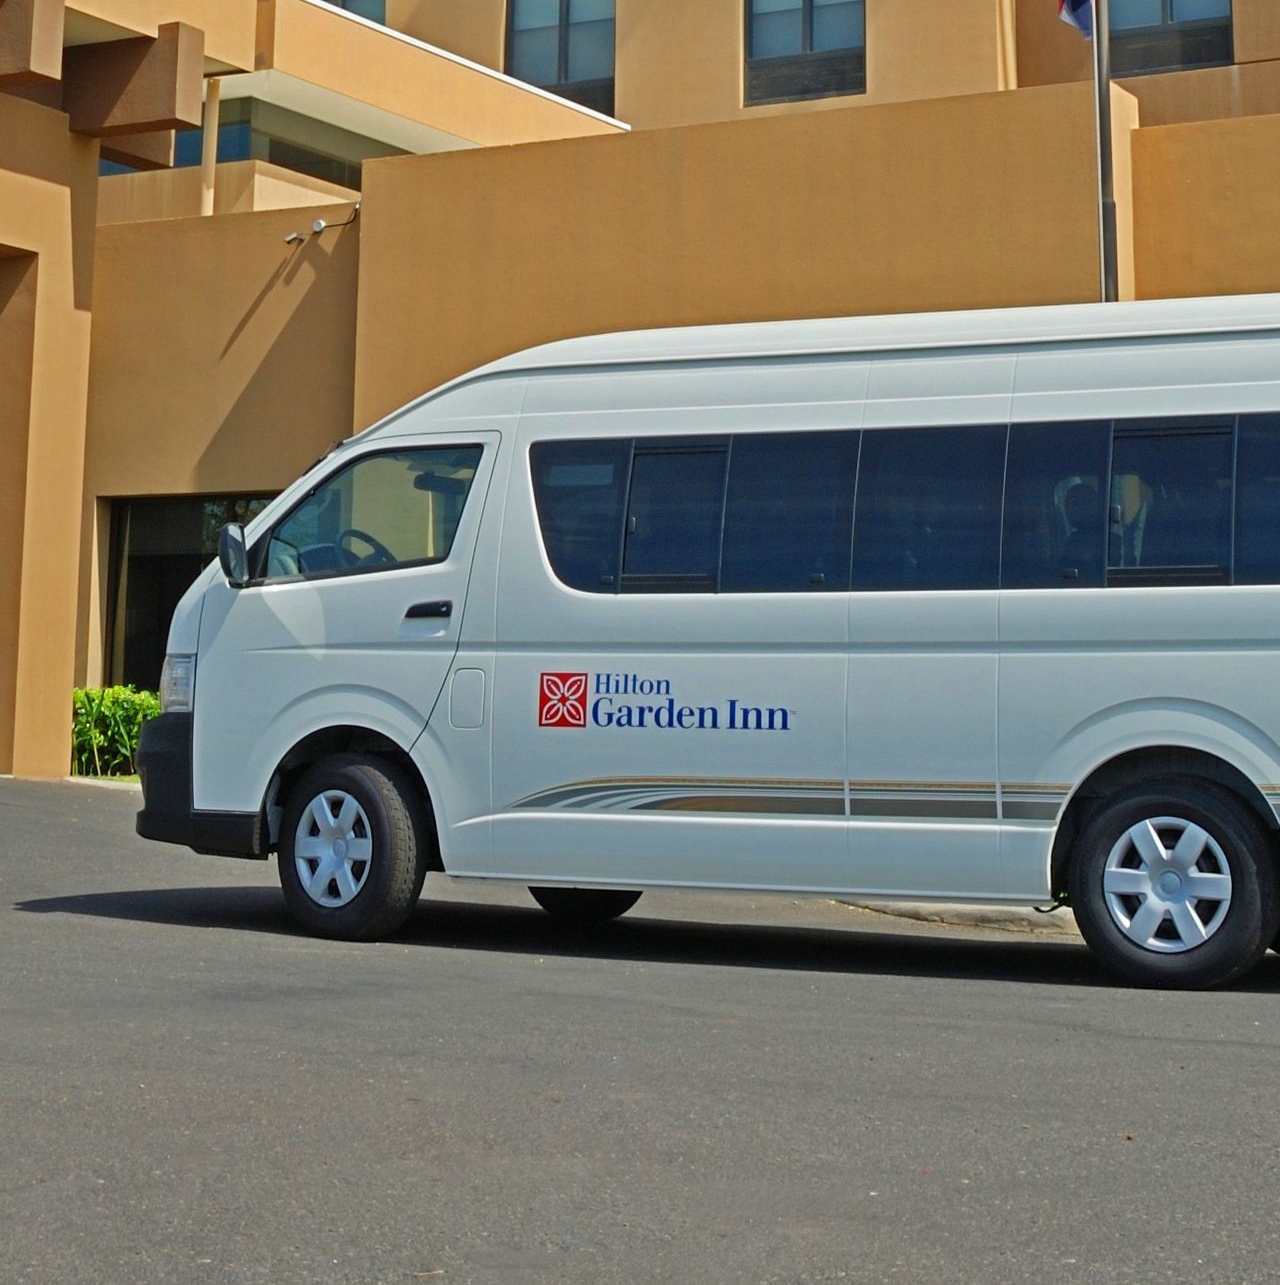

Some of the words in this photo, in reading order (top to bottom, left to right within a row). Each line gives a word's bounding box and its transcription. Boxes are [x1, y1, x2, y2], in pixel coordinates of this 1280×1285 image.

[594, 673, 671, 695] Hilton
[592, 697, 720, 729] Garden
[726, 699, 791, 730] Inn
